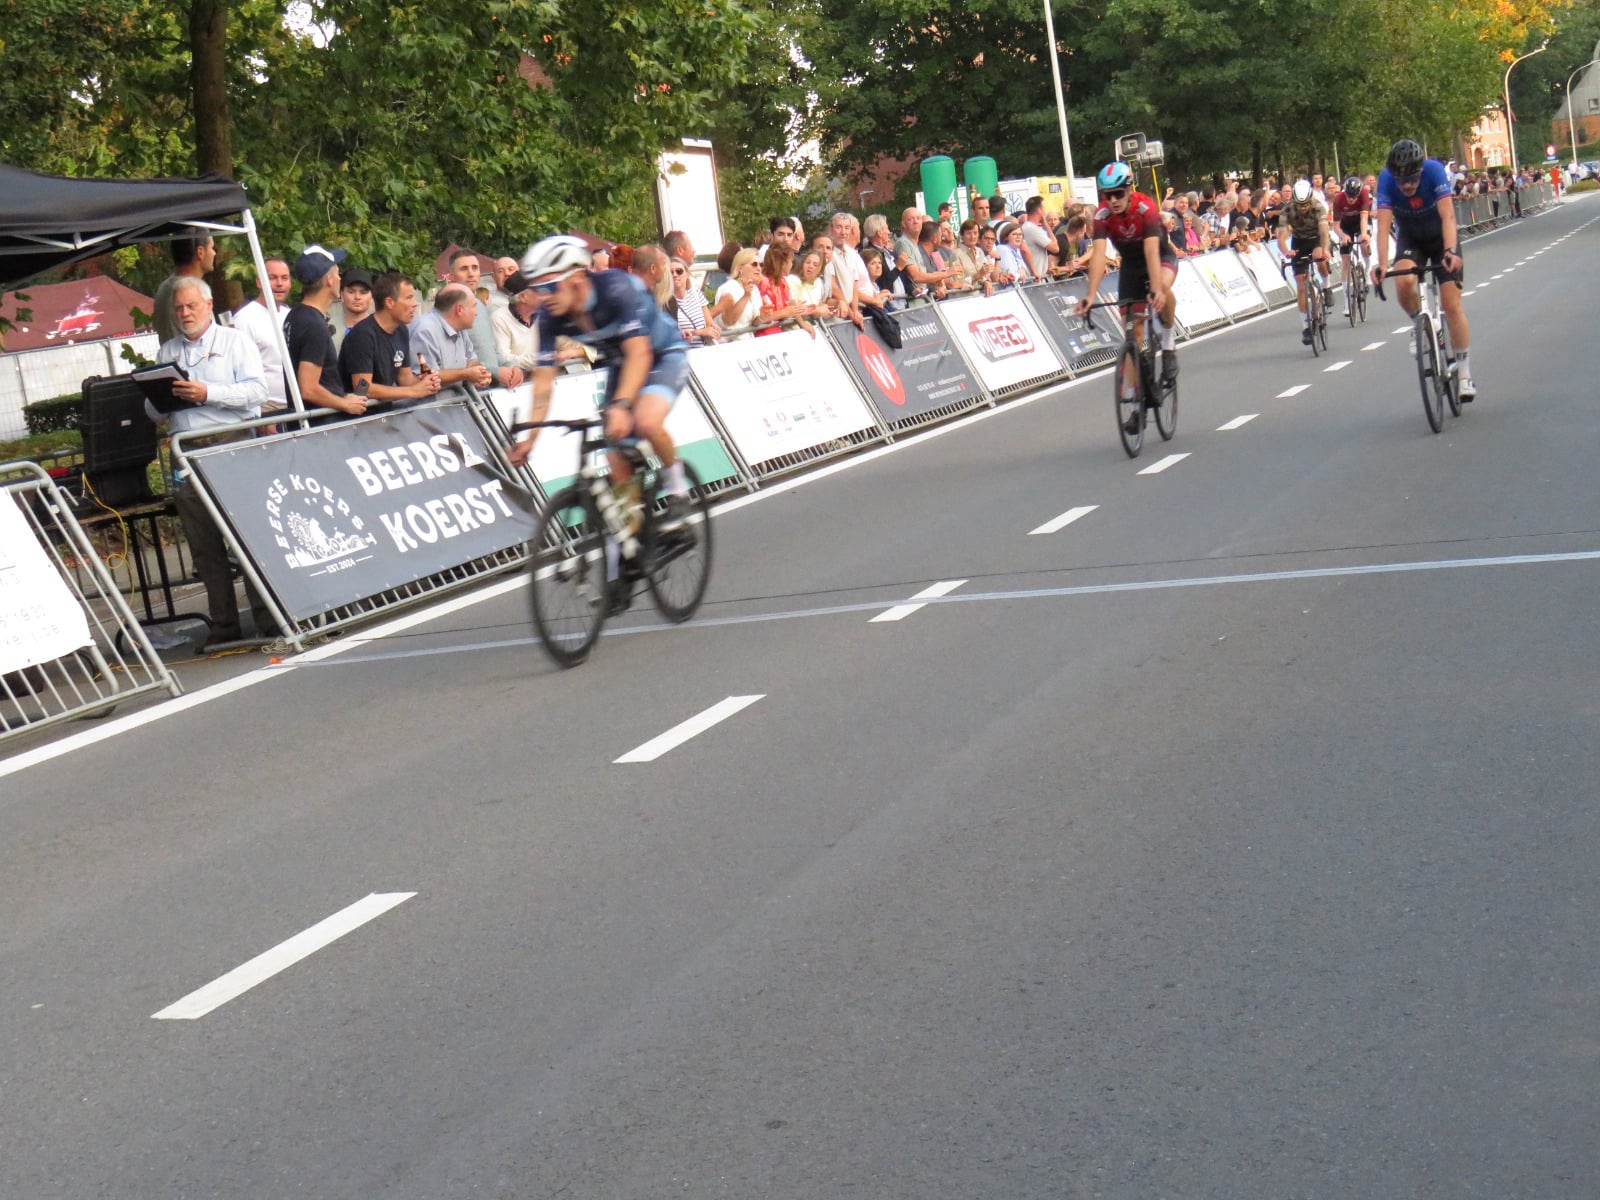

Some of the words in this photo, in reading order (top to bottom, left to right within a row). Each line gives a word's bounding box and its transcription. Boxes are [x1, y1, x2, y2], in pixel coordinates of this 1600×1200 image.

[864, 352, 897, 390] W
[289, 473, 377, 545] KOERST
[379, 479, 513, 553] KOERST
